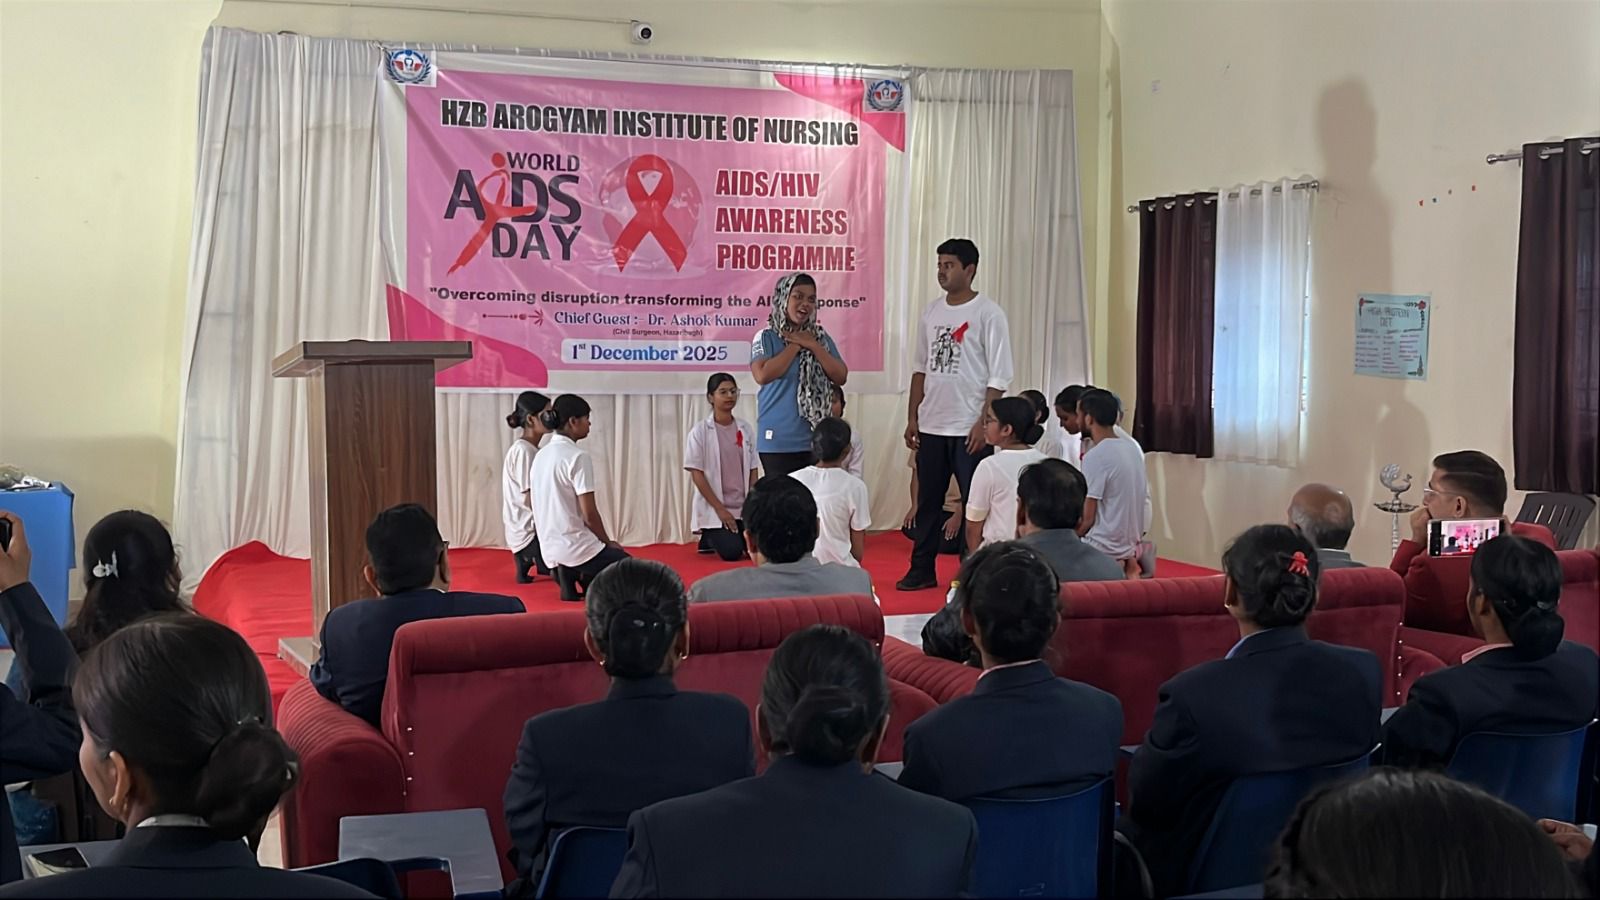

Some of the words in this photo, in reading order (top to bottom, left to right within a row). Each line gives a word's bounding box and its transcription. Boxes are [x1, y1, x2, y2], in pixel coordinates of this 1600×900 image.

[441, 99, 487, 128] HZB
[492, 103, 607, 134] AROGYAM
[613, 110, 727, 141] INSTITUTE
[732, 116, 759, 142] OF
[764, 118, 859, 146] NURSING
[507, 151, 580, 172] WORLD
[715, 170, 820, 197] AIDS/HIV
[715, 207, 848, 235] AWARENESS
[491, 222, 582, 261] DAY
[717, 244, 856, 271] PROGRAMME
[429, 286, 536, 305] "Overcoming
[541, 291, 620, 306] disruption
[624, 294, 722, 309] transforming
[728, 296, 752, 307] the
[554, 311, 590, 325] Chief
[592, 312, 630, 325] Guest
[648, 314, 667, 326] Dr.
[670, 315, 711, 327] Ashok
[715, 315, 758, 327] Kumar
[590, 344, 678, 361] December
[683, 345, 728, 361] 2025
